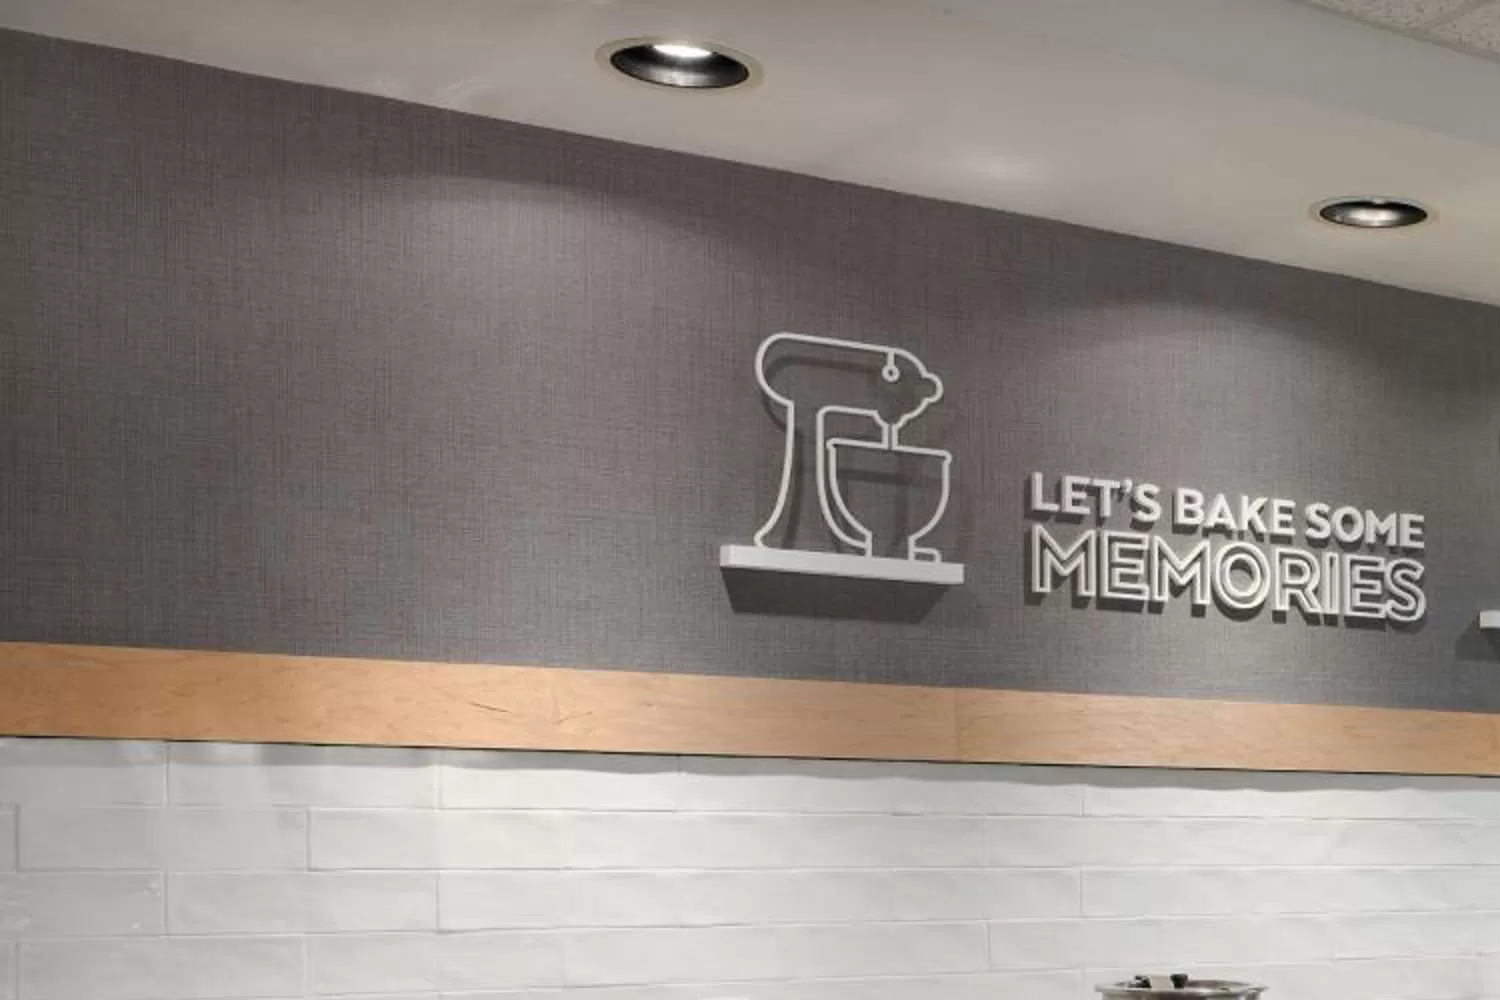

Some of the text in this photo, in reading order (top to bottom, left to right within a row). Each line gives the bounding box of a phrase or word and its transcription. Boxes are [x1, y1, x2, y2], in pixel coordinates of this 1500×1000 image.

[1031, 472, 1425, 549] LET'S BAKE SOME
[1030, 524, 1427, 622] MEMORIES
